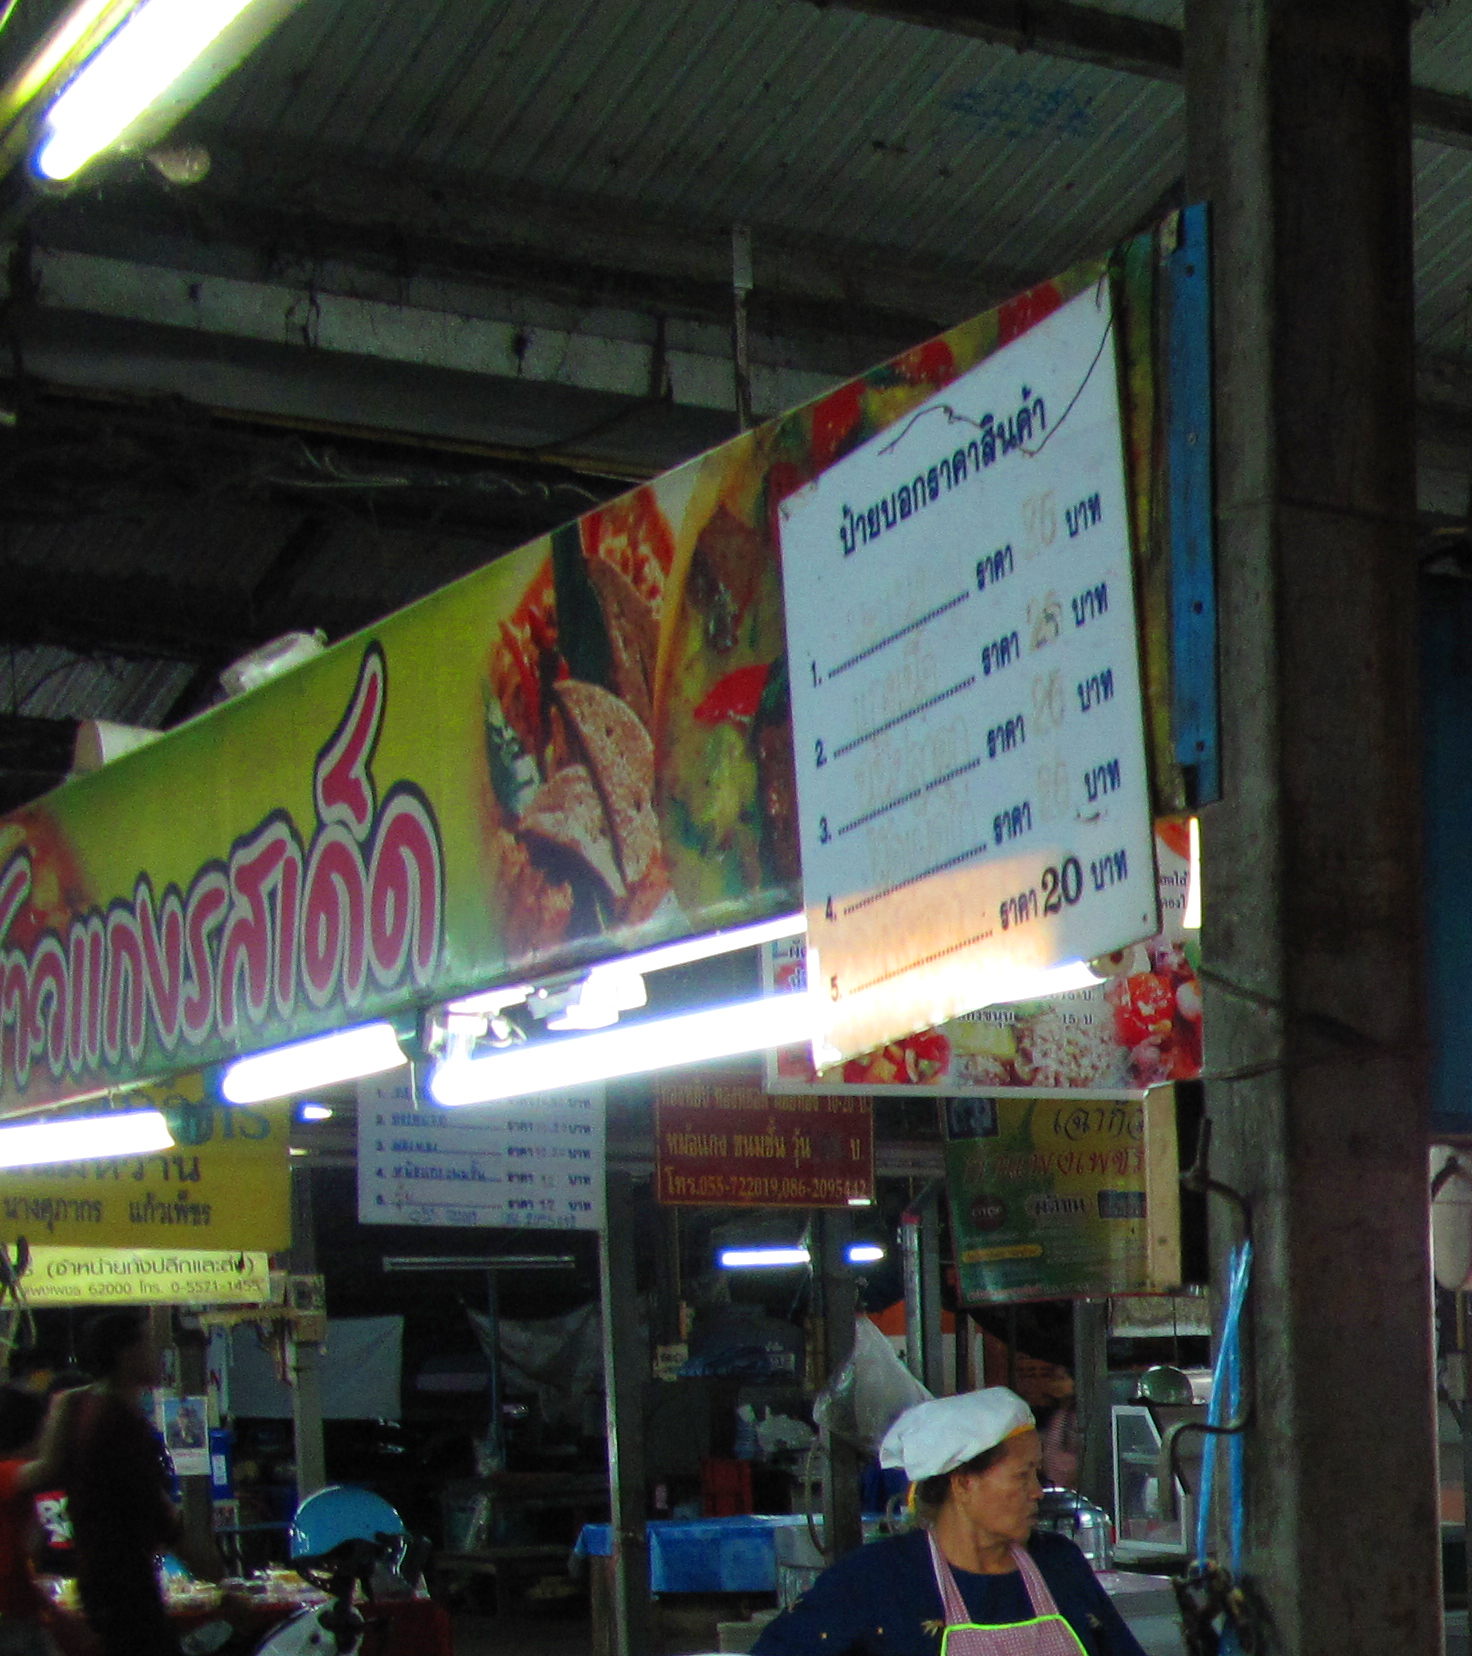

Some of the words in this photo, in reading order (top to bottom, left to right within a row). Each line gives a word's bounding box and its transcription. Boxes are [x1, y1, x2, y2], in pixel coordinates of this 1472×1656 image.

[839, 384, 1048, 558] ป้ายบอกราคาสินค้า
[976, 544, 1014, 590] ราคา
[1066, 491, 1102, 539] บาท
[981, 630, 1019, 676] ราคา
[1072, 581, 1109, 628] บาท
[987, 714, 1025, 760] ราคา
[1078, 667, 1115, 713] บาท
[992, 806, 1031, 845] ราคา
[1085, 757, 1122, 803] บาท
[0, 638, 444, 1094] าวแกงรสเด็ด
[1000, 888, 1039, 931] ราคา
[1040, 851, 1084, 919] 20
[1089, 846, 1128, 894] บาท
[88, 1281, 132, 1295] 62000
